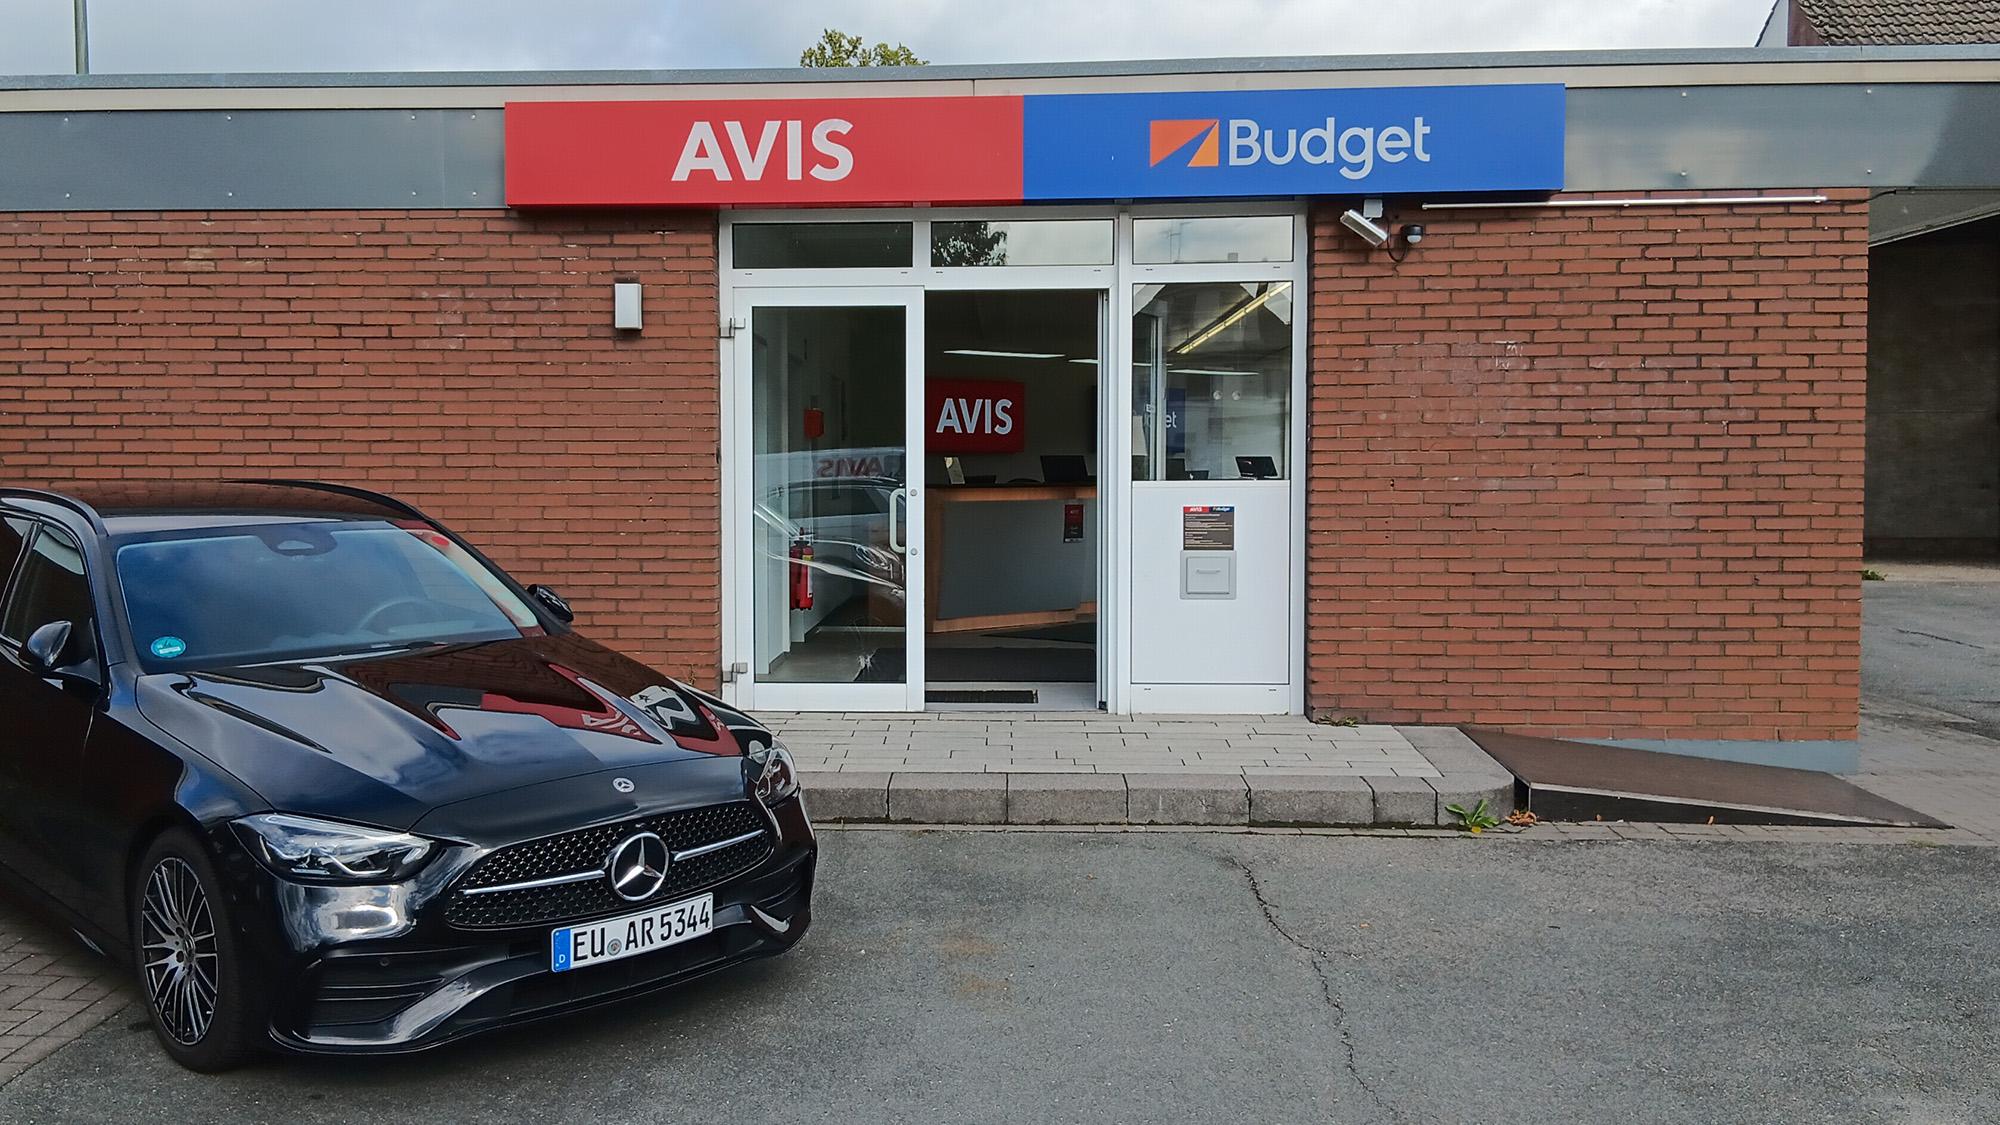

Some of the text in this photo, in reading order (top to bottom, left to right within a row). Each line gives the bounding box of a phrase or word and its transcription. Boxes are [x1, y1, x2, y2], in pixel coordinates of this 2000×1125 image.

[672, 119, 853, 181] AVIS
[1229, 116, 1431, 180] Budget
[936, 398, 1012, 434] AVIS
[559, 901, 710, 963] D EU AR 5344
